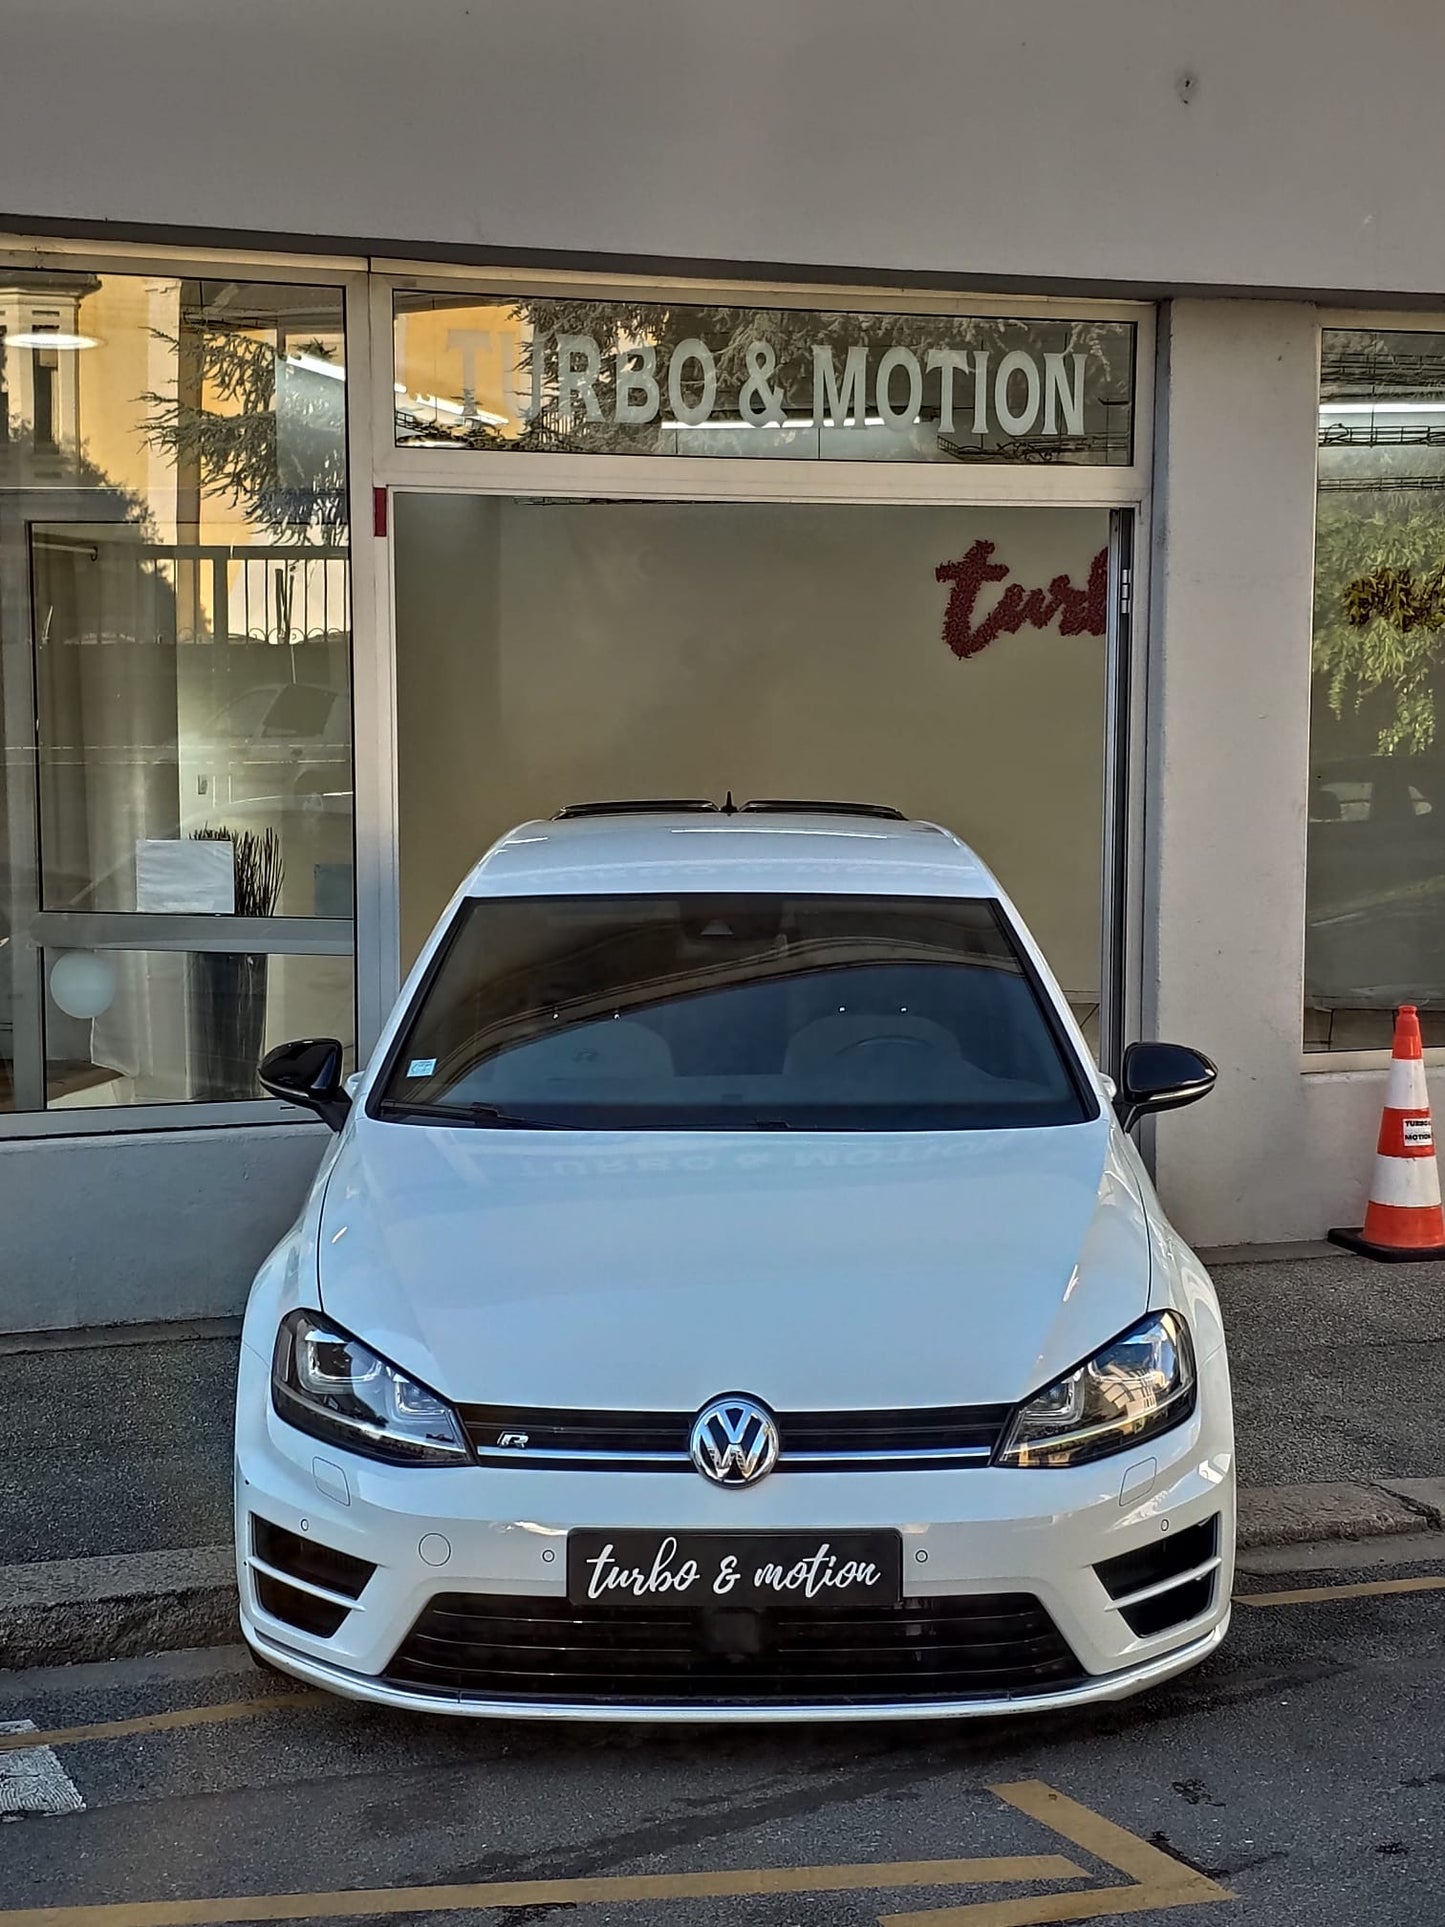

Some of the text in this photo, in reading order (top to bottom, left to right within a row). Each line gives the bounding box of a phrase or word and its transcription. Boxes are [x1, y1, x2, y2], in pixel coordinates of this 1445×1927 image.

[446, 328, 1089, 436] TURBO & MOTION
[697, 1404, 771, 1482] VW
[586, 1537, 881, 1599] turbo & motion
